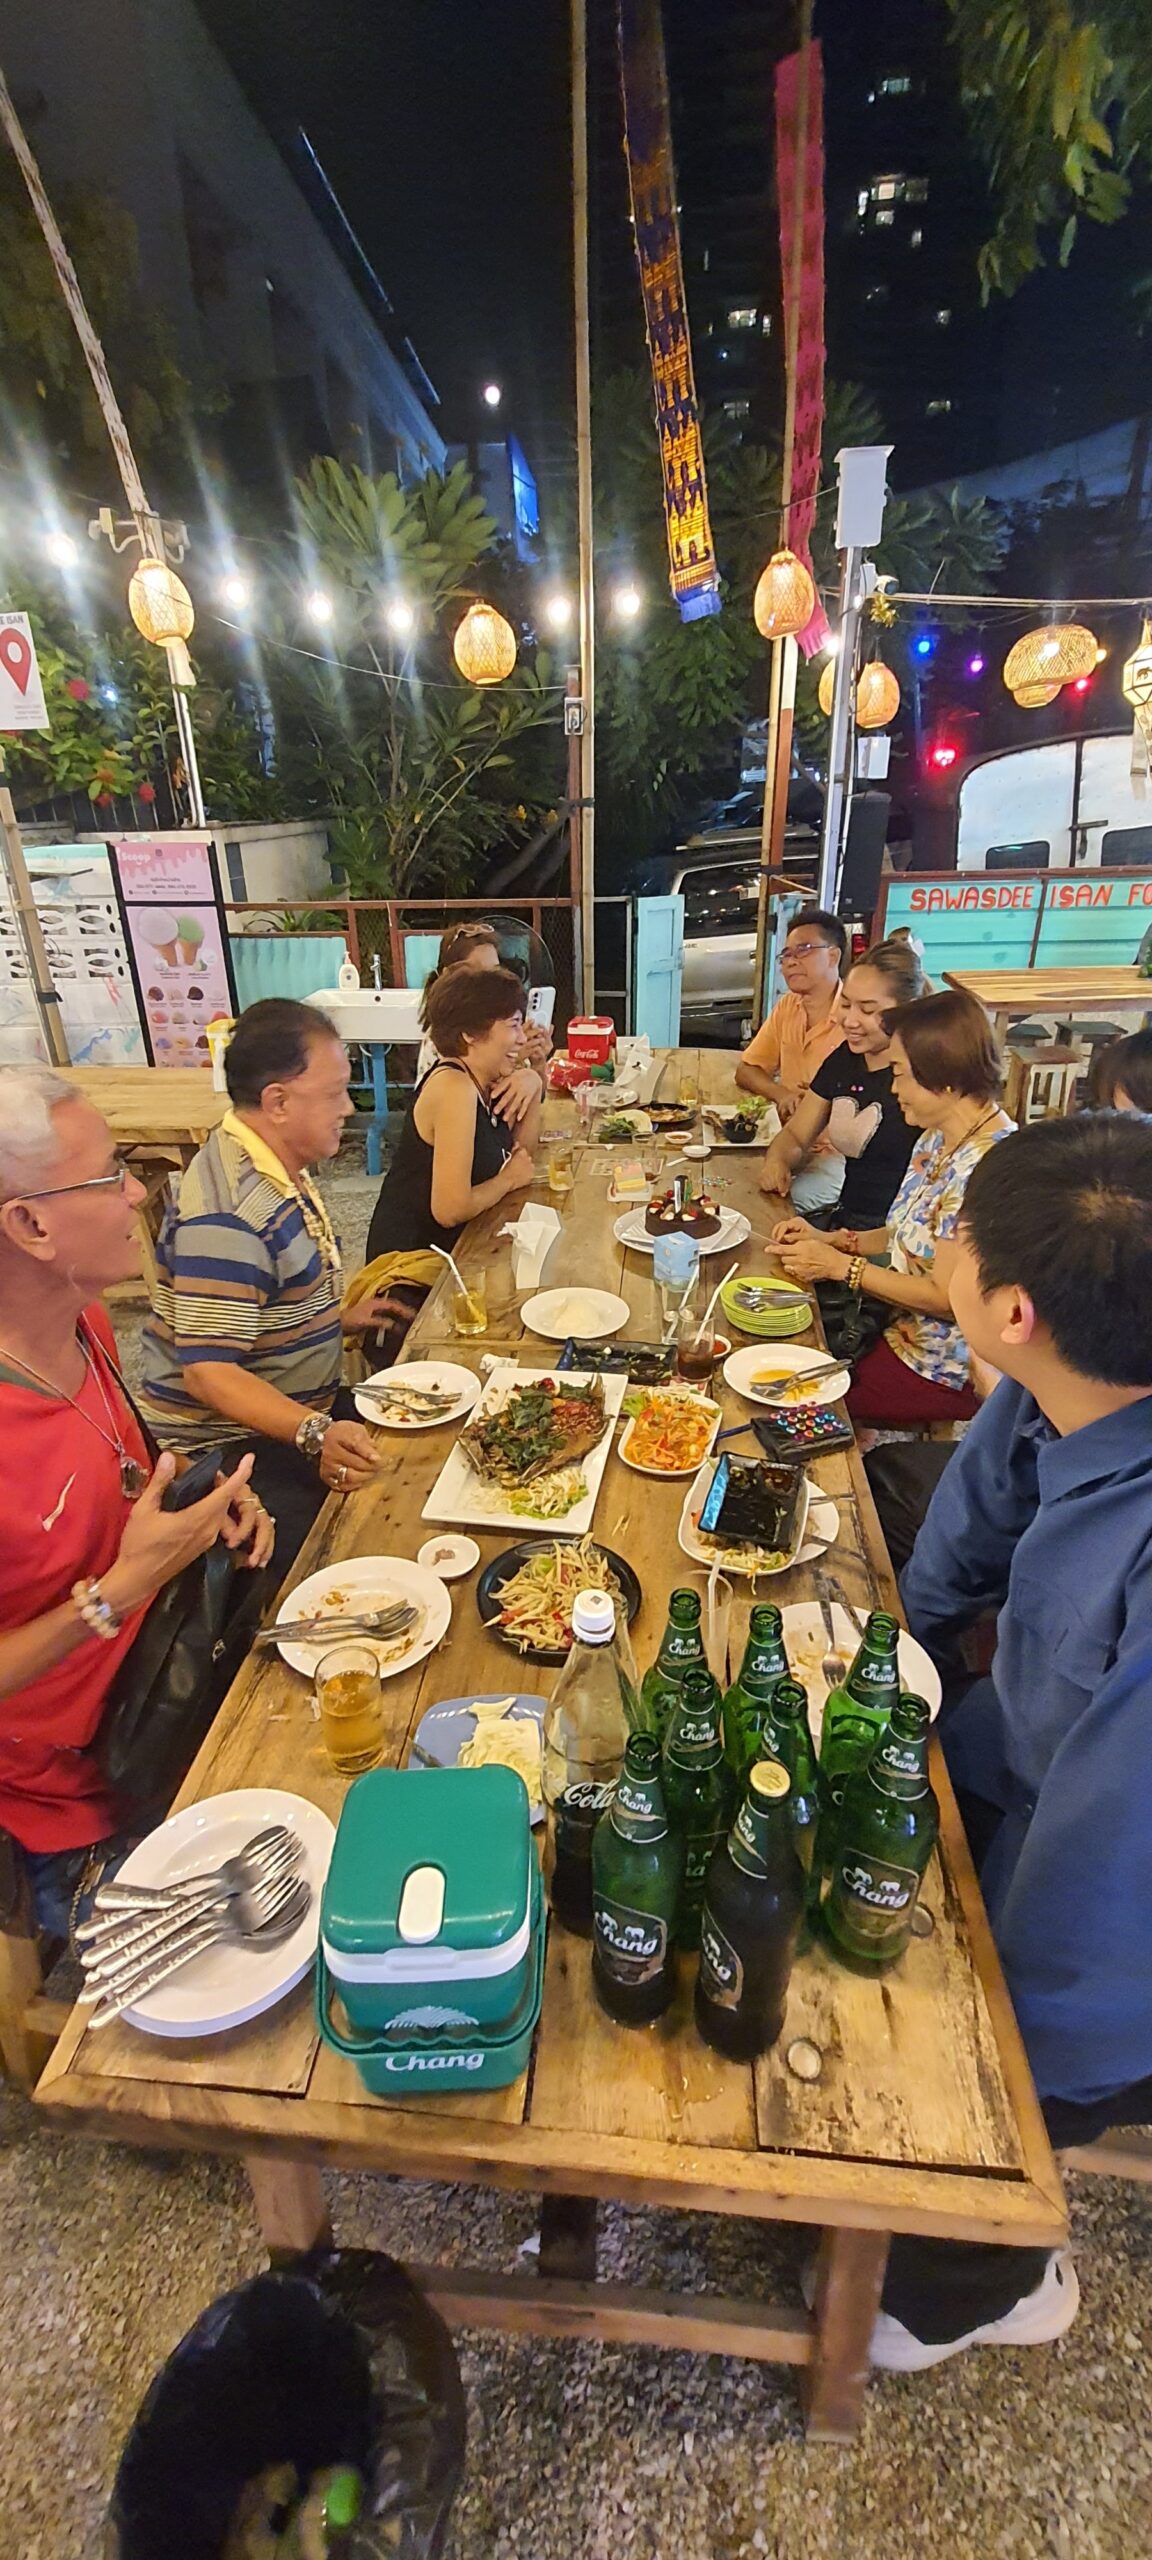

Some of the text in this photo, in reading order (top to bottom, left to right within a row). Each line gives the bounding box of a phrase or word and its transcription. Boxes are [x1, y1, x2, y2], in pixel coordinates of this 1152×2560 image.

[909, 886, 1035, 913] SAWASDEE
[1049, 884, 1114, 909] ISAN
[668, 1642, 700, 1655] Chang
[751, 1659, 784, 1673] Chang
[861, 1666, 896, 1683] Chang
[680, 1727, 715, 1741] Chang
[882, 1747, 920, 1773] Chang
[563, 1779, 619, 1809] Cola
[618, 1786, 652, 1814] Chang
[842, 1867, 910, 1908] Chang
[385, 2053, 485, 2071] Chang
